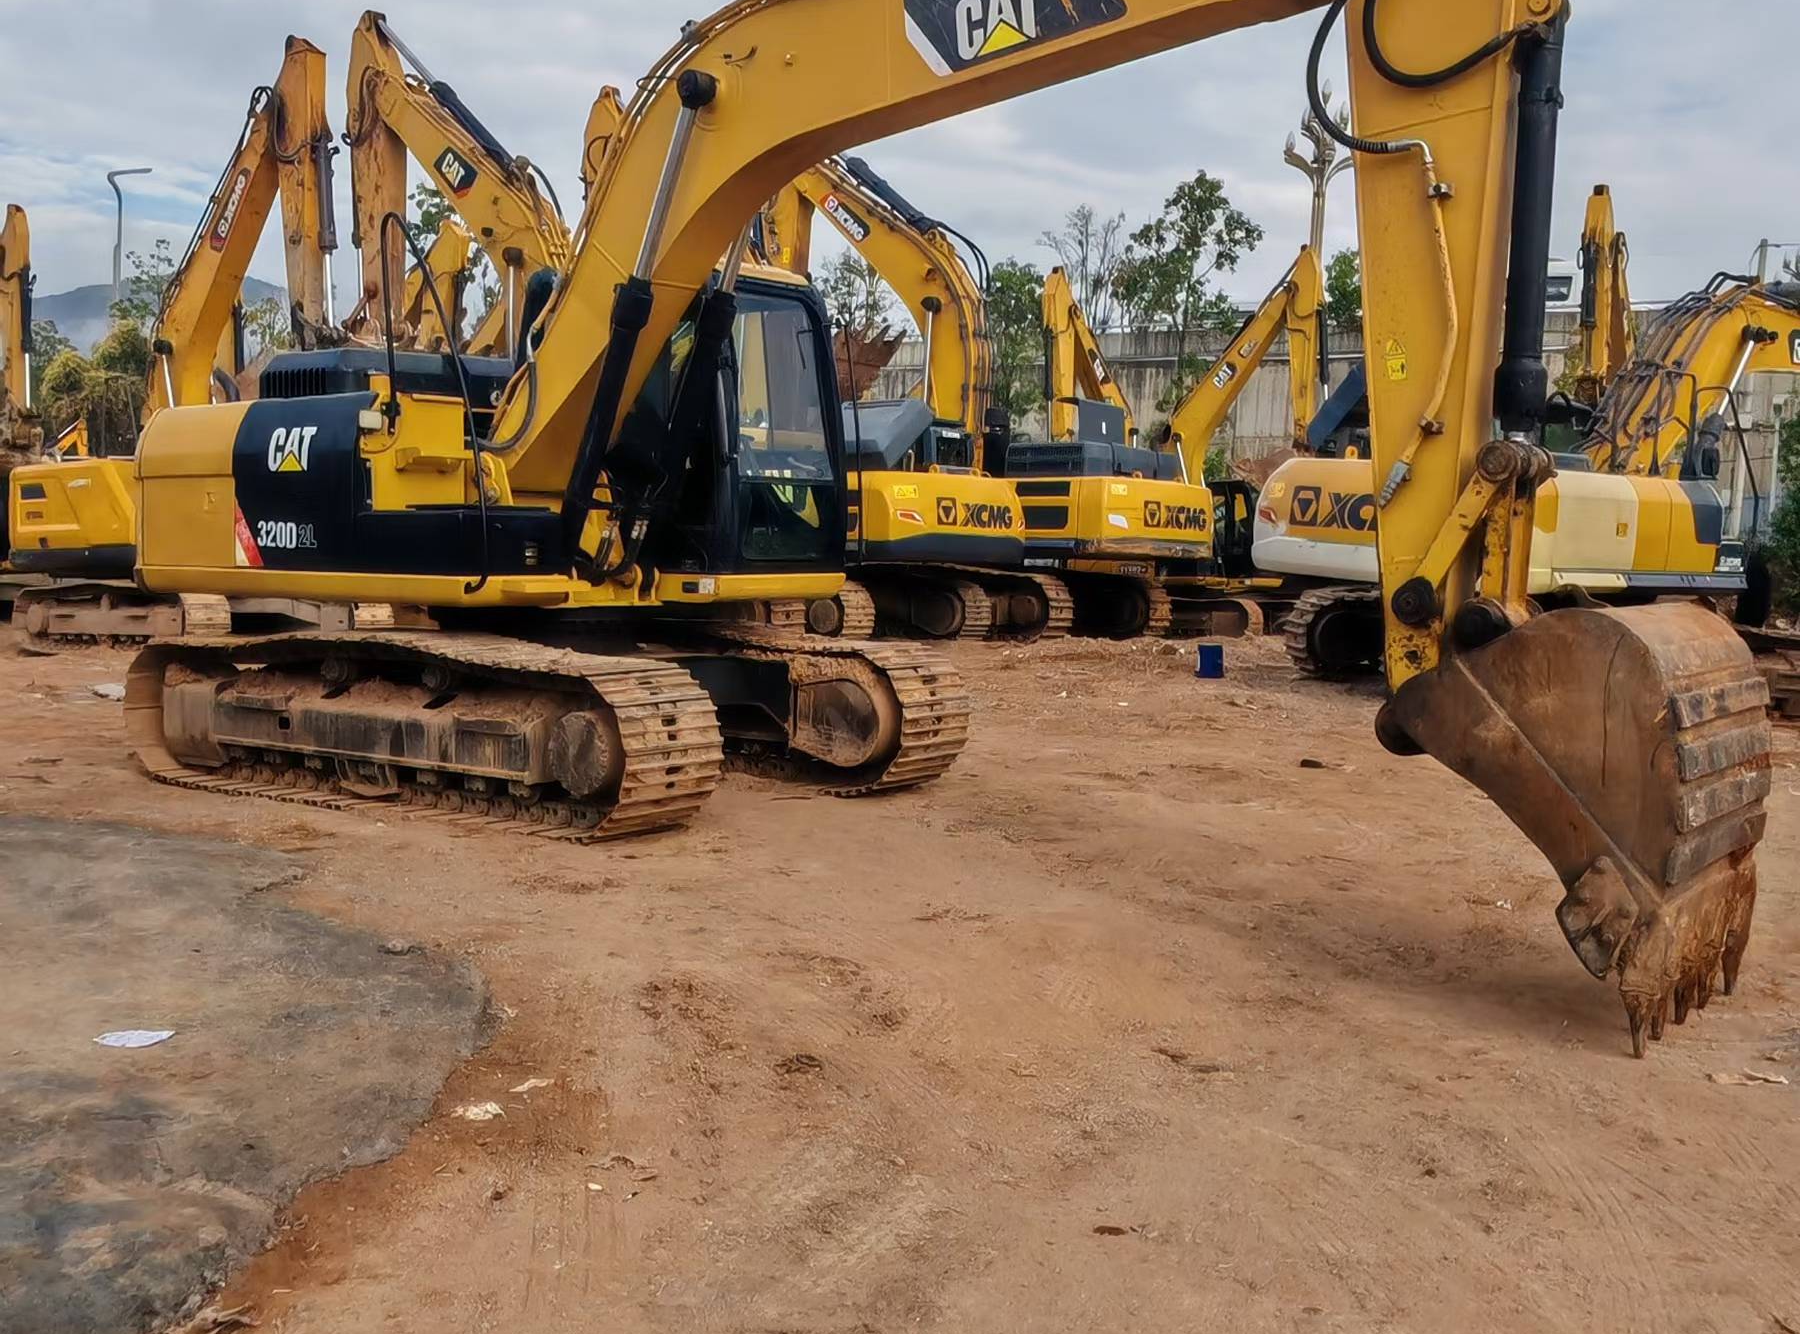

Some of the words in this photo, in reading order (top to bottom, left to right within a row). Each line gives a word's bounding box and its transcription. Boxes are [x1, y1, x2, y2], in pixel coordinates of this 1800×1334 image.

[441, 152, 465, 188] CAT
[223, 174, 246, 226] XCMG
[1212, 363, 1233, 388] CAT
[267, 426, 318, 471] CAT
[960, 503, 1013, 529] XCMG
[1162, 505, 1207, 531] XCMG
[1319, 492, 1377, 531] XC
